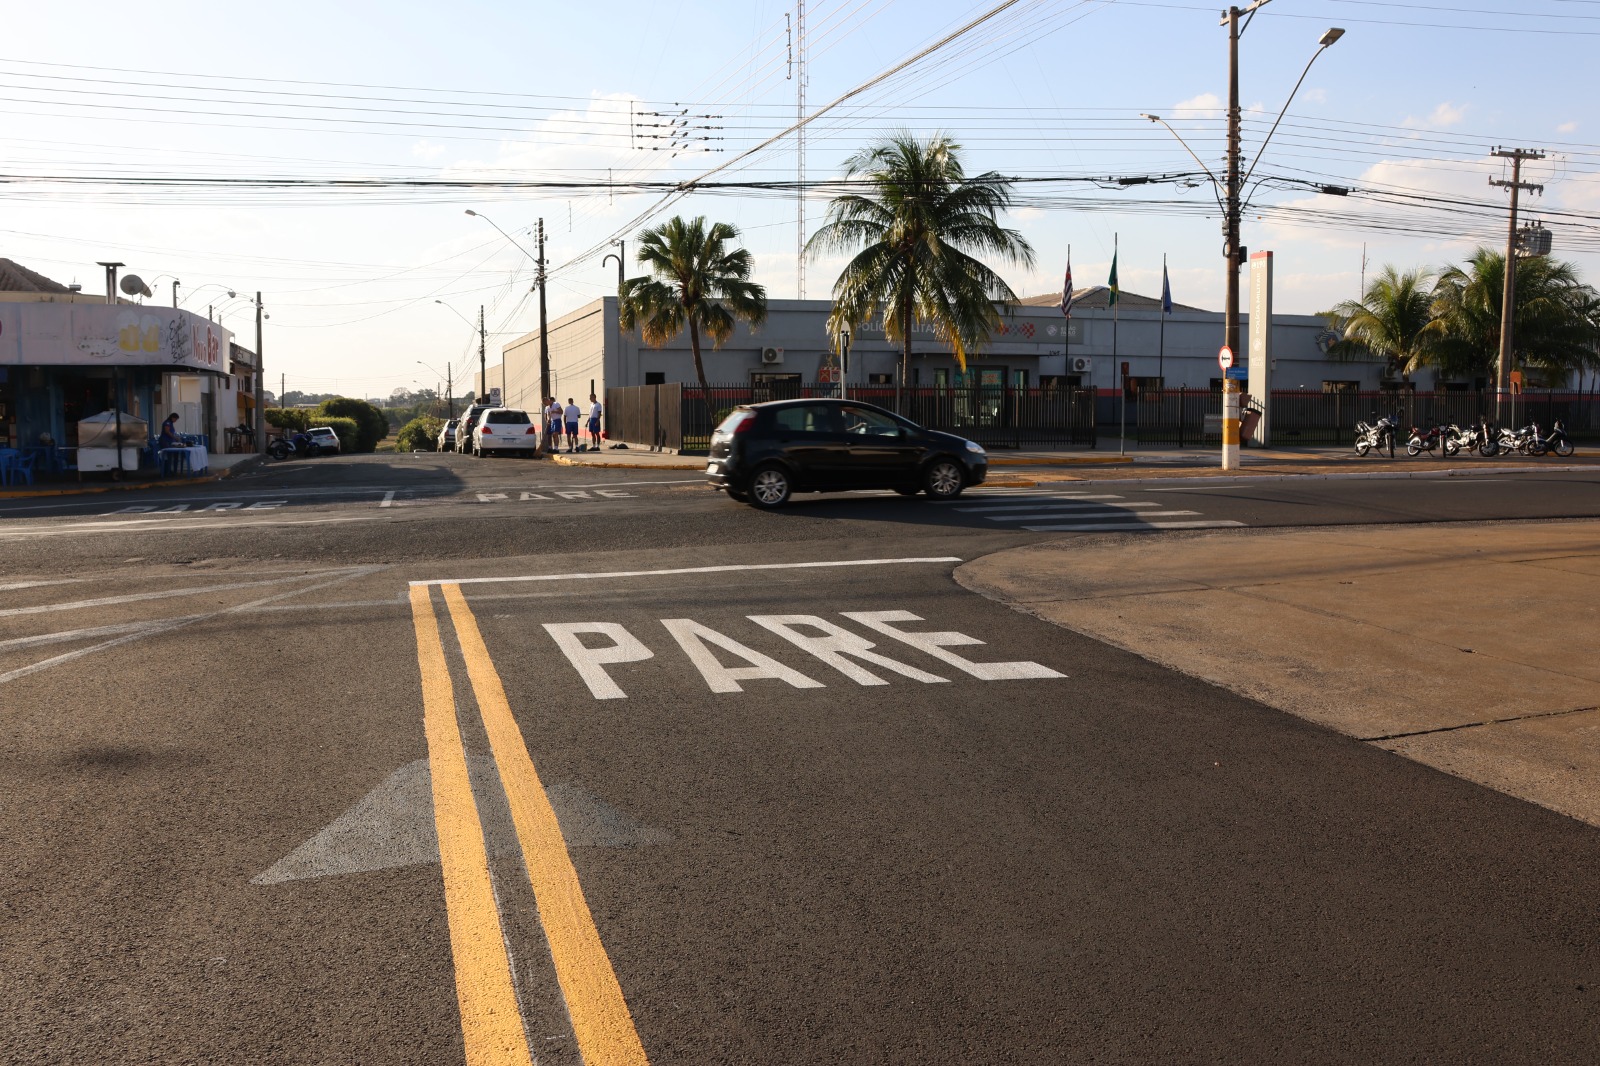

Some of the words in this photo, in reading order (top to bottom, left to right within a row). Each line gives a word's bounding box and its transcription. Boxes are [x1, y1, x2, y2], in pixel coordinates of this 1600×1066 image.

[856, 320, 890, 332] POLÍC
[207, 324, 219, 367] Bar
[475, 490, 639, 502] PARE
[540, 609, 1070, 700] PARE
